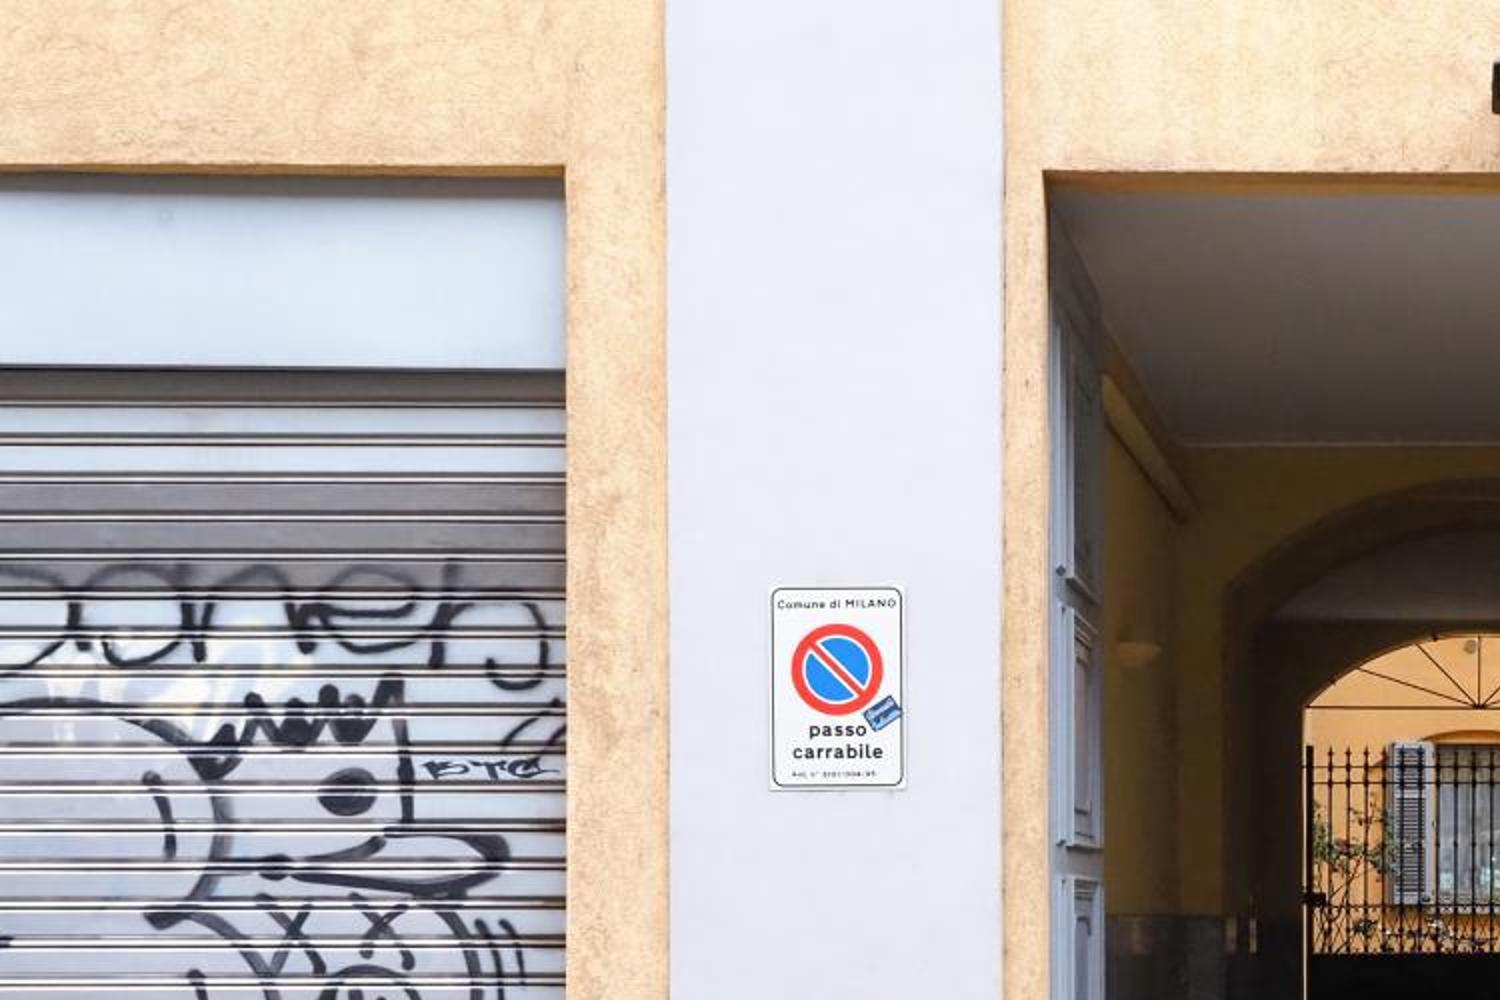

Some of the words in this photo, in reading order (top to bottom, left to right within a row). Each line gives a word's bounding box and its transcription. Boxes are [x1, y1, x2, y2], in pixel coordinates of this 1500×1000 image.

[777, 599, 826, 610] Comune
[829, 598, 842, 610] di
[845, 598, 897, 609] MILANO
[809, 723, 868, 740] passo
[793, 744, 884, 760] carrabile
